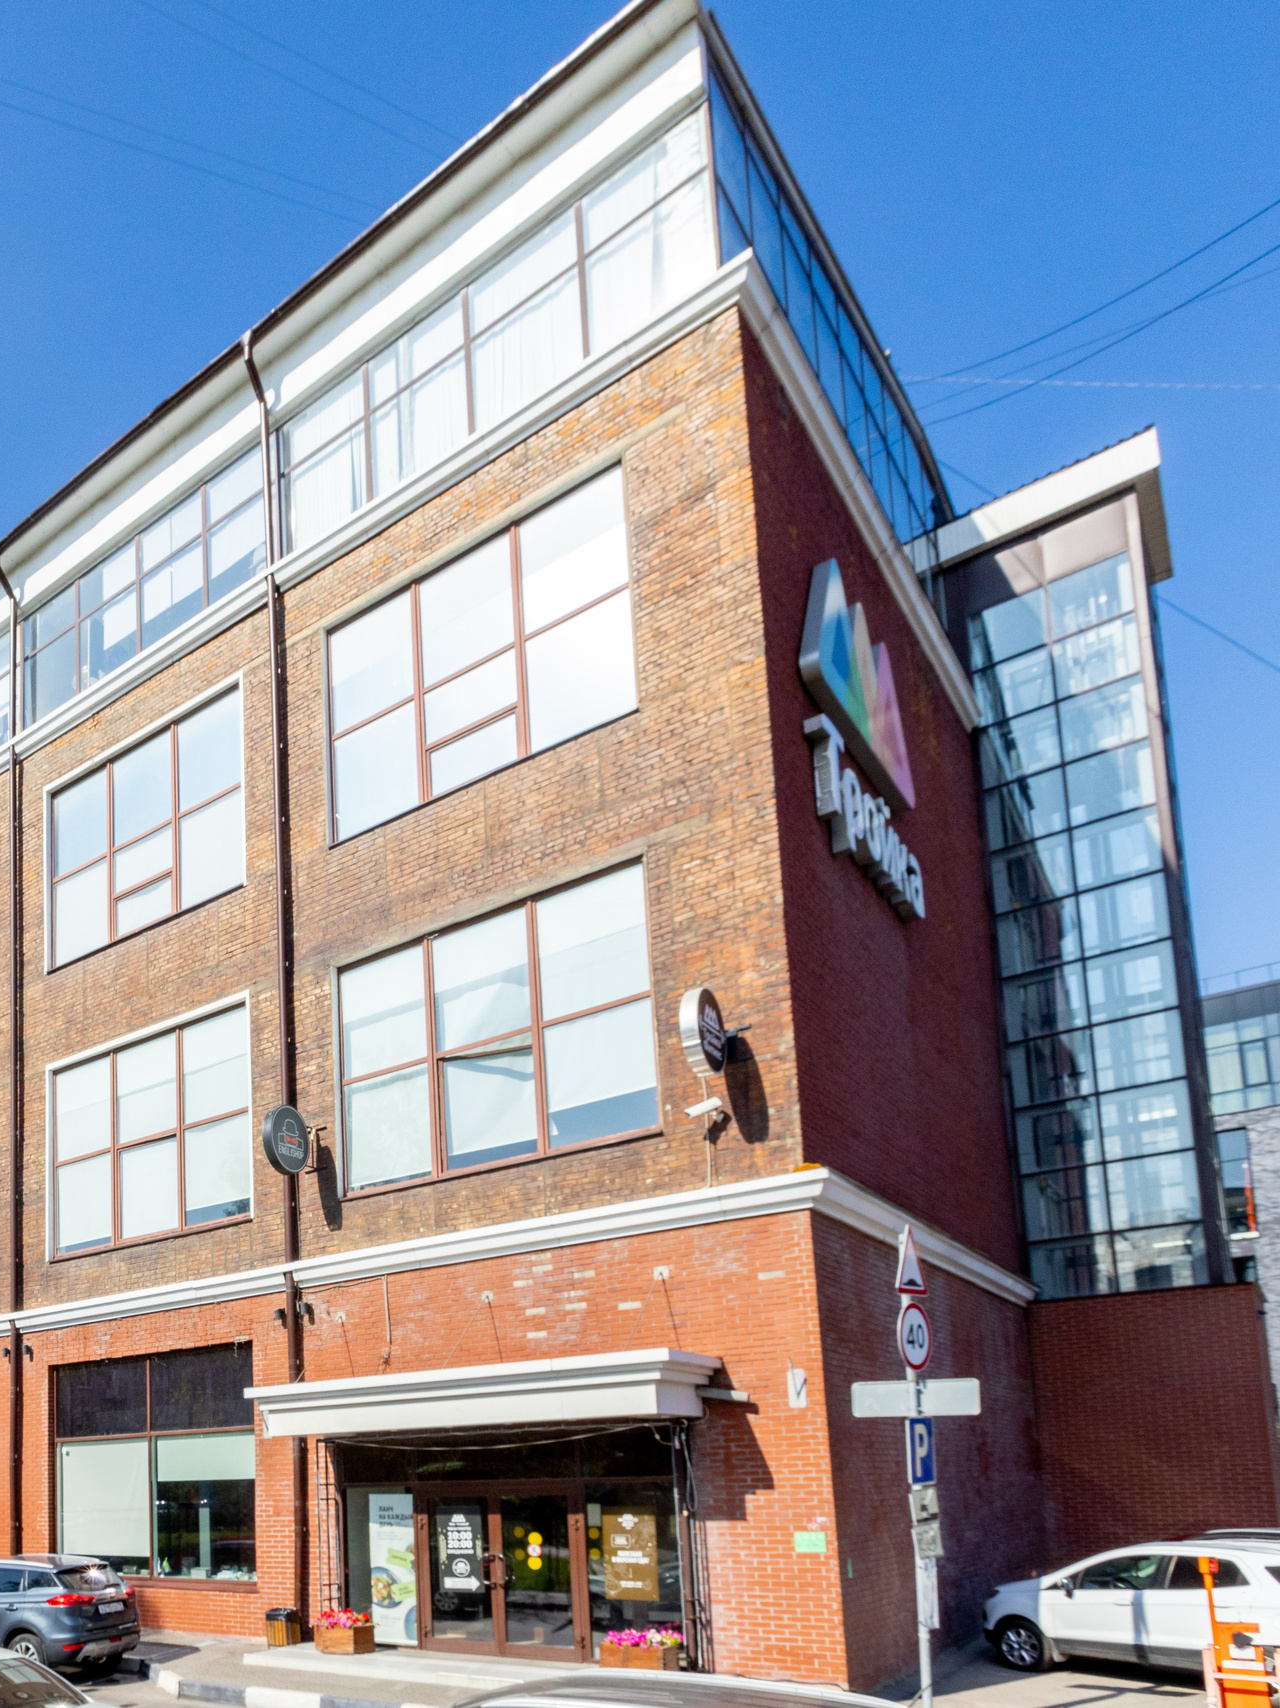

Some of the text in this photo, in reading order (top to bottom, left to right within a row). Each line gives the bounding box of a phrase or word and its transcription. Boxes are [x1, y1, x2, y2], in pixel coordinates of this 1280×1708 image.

[803, 713, 926, 921] Тройка
[278, 1145, 305, 1160] ENGLISHOP
[906, 1325, 925, 1349] 40
[914, 1423, 929, 1478] P
[447, 1531, 473, 1540] 10:00
[447, 1540, 473, 1549] 20:00
